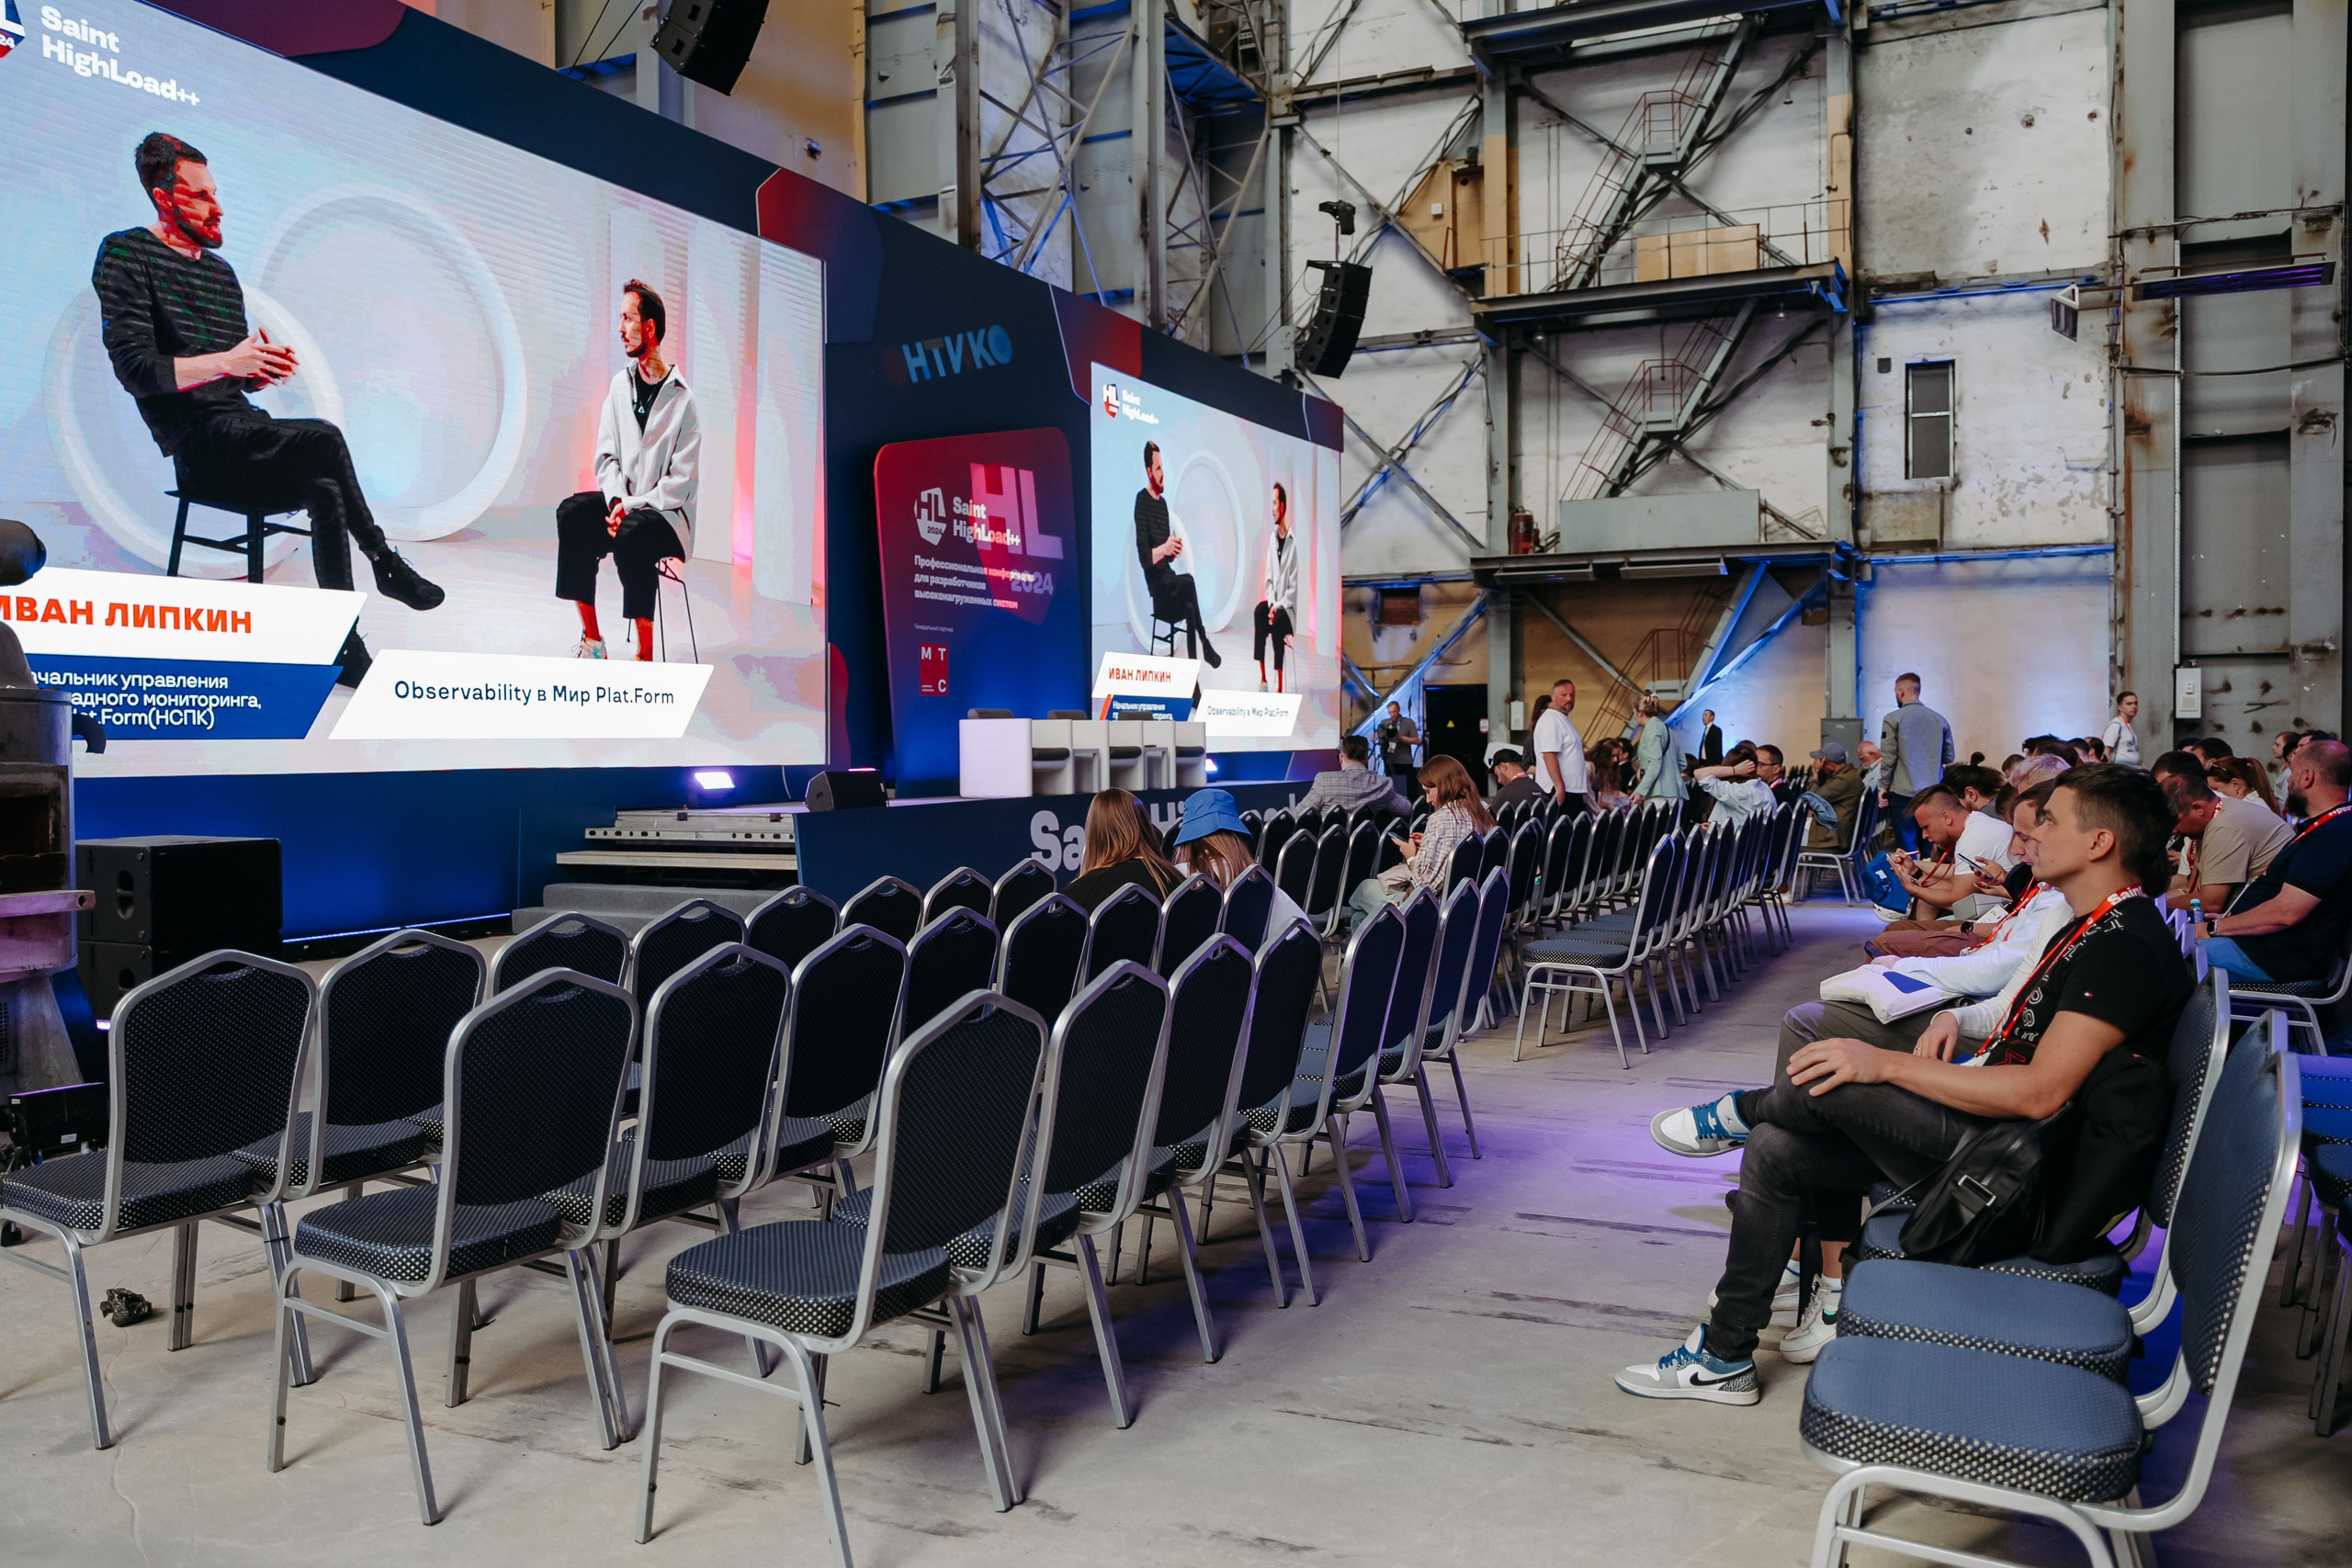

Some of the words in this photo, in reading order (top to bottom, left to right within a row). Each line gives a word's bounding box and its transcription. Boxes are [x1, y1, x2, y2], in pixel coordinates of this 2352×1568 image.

[40, 6, 119, 53] Saint
[42, 34, 200, 107] HighLoad++
[953, 496, 987, 519] Saint
[953, 519, 1021, 547] HighLoad++
[105, 603, 252, 634] ЛИПКИН
[121, 673, 229, 691] управления
[1108, 667, 1134, 681] ИВАН
[1135, 669, 1171, 682] ЛИПКИН
[143, 694, 261, 710] мониторинга,
[394, 681, 532, 705] Observability
[552, 685, 590, 706] Мир
[596, 687, 674, 705] Plat.Form
